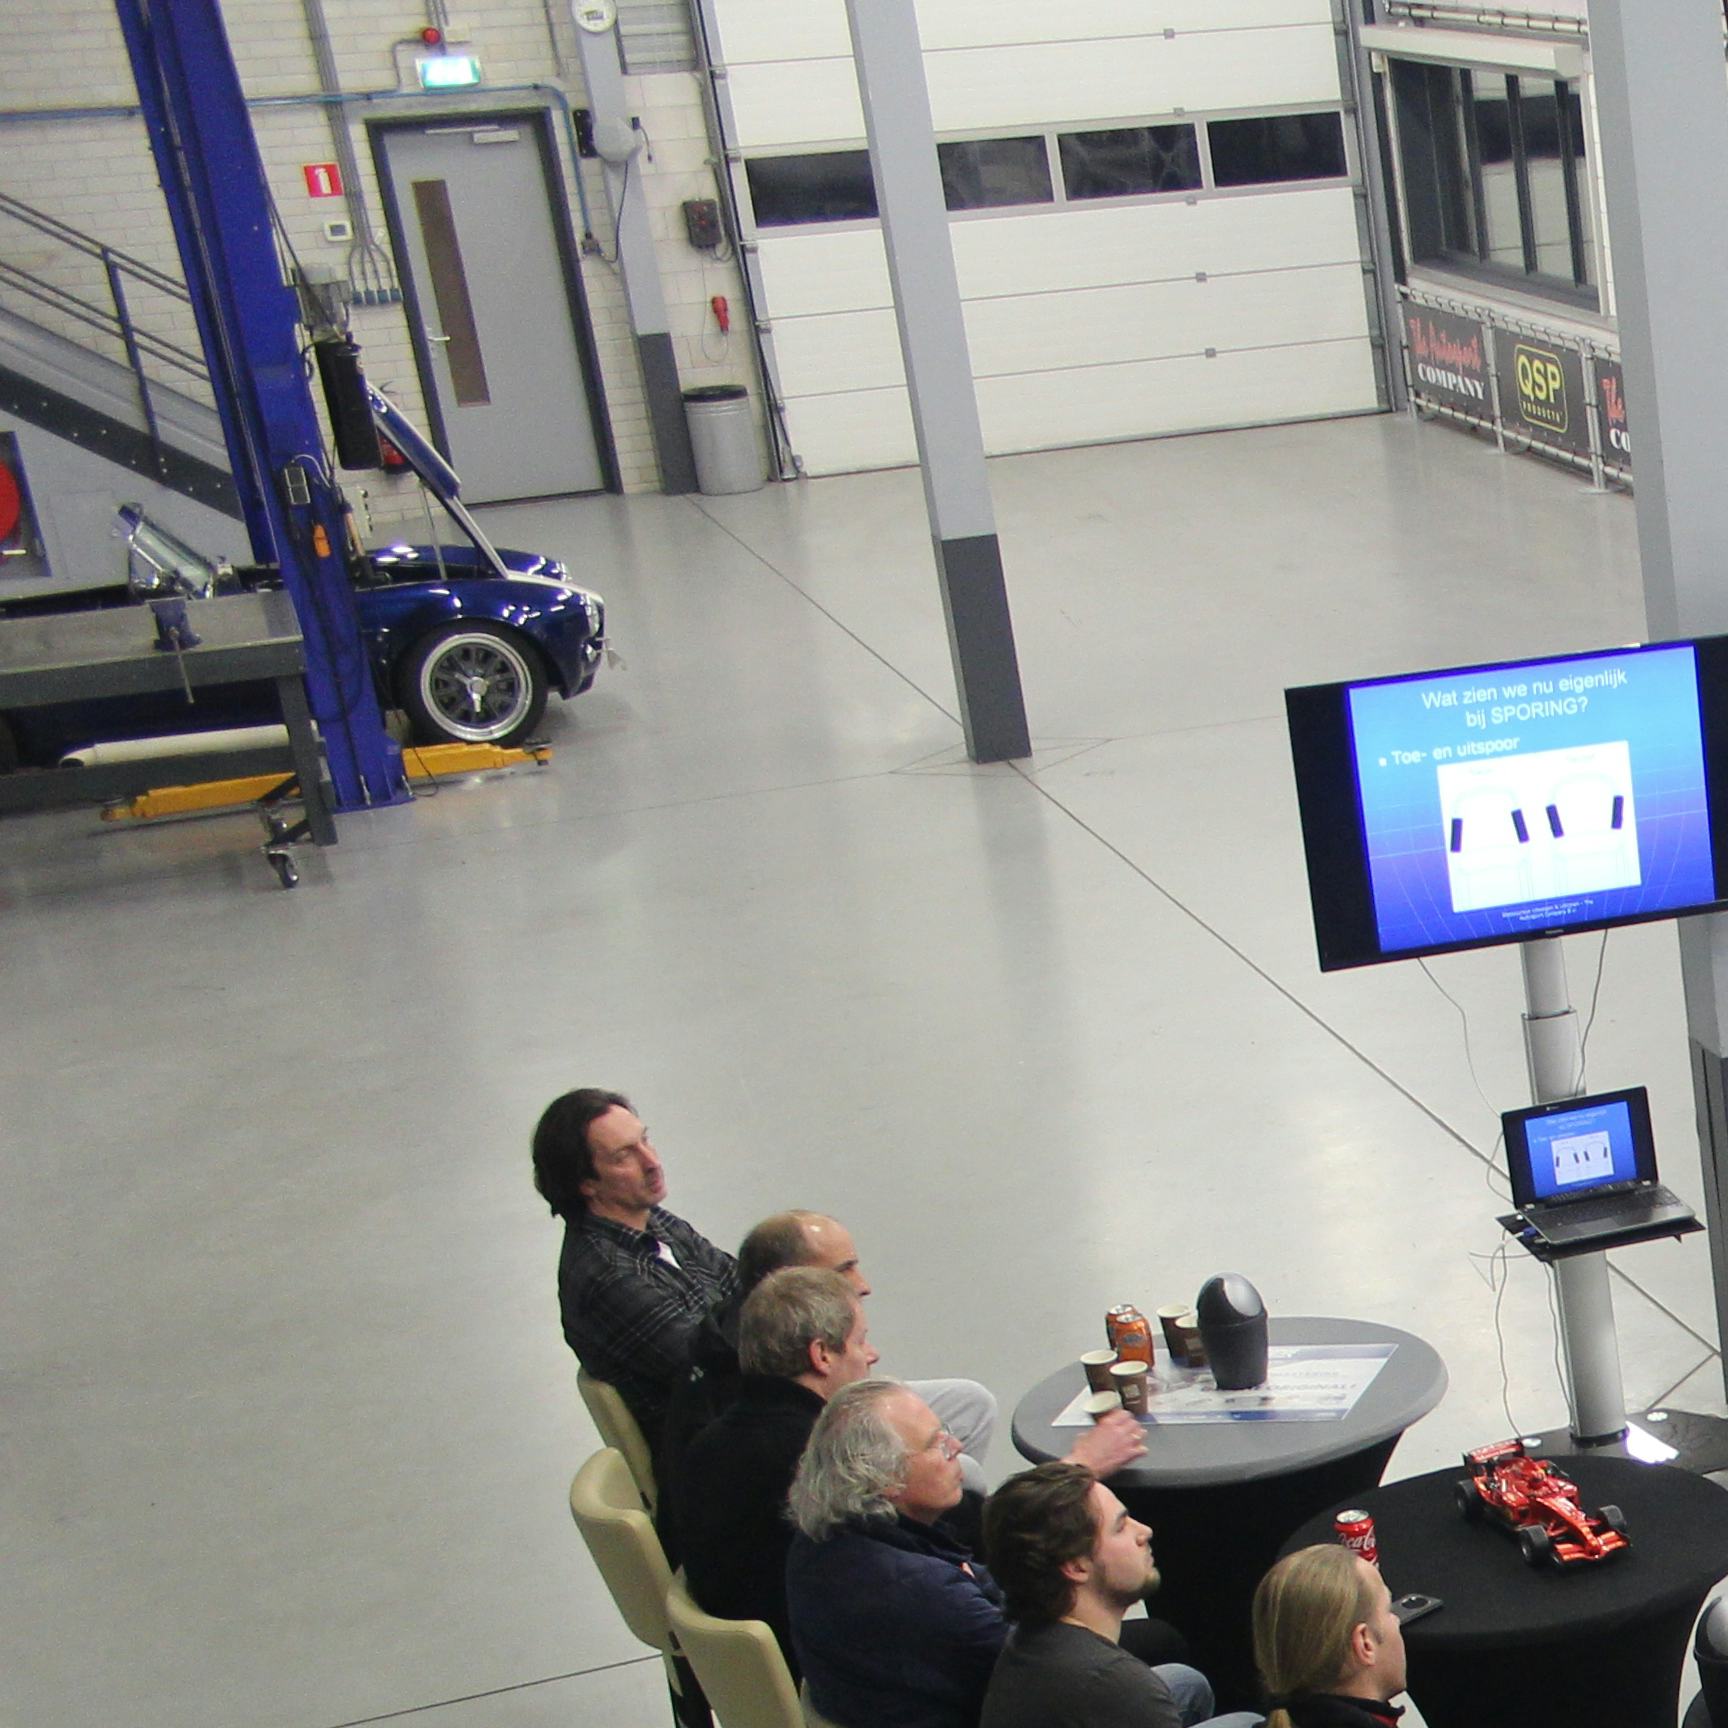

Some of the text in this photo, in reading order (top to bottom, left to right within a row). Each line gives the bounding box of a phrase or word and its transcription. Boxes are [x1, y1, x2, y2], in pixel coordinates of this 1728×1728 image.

[1417, 362, 1485, 400] COMPANY
[1517, 354, 1561, 404] QSP
[1421, 668, 1628, 709] Wat zien we nu eigenlijk
[1466, 697, 1589, 730] bij SPORING?
[1391, 737, 1521, 766] Toe- en uitspoor
